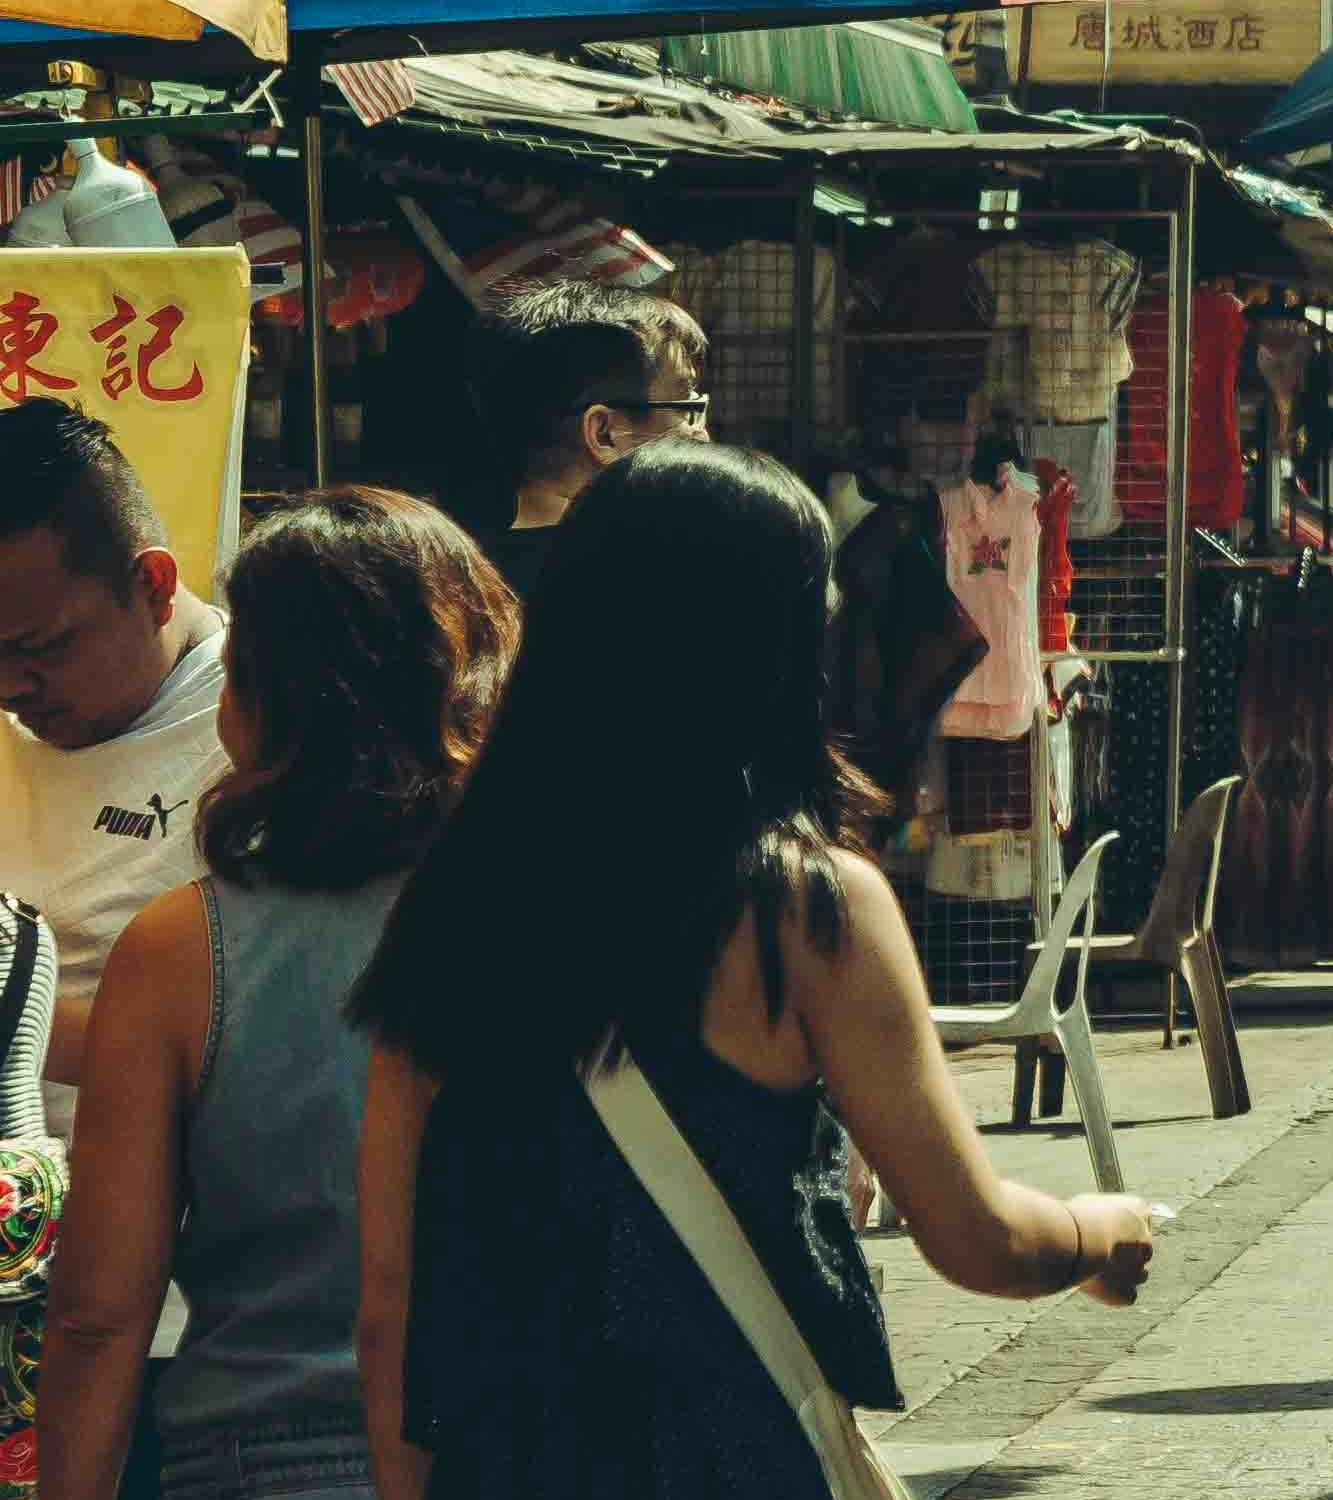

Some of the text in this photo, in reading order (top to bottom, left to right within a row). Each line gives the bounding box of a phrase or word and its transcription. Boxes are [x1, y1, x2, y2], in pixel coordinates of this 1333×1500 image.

[1069, 12, 1265, 52] 唐城酒店
[93, 804, 155, 841] PUMA
